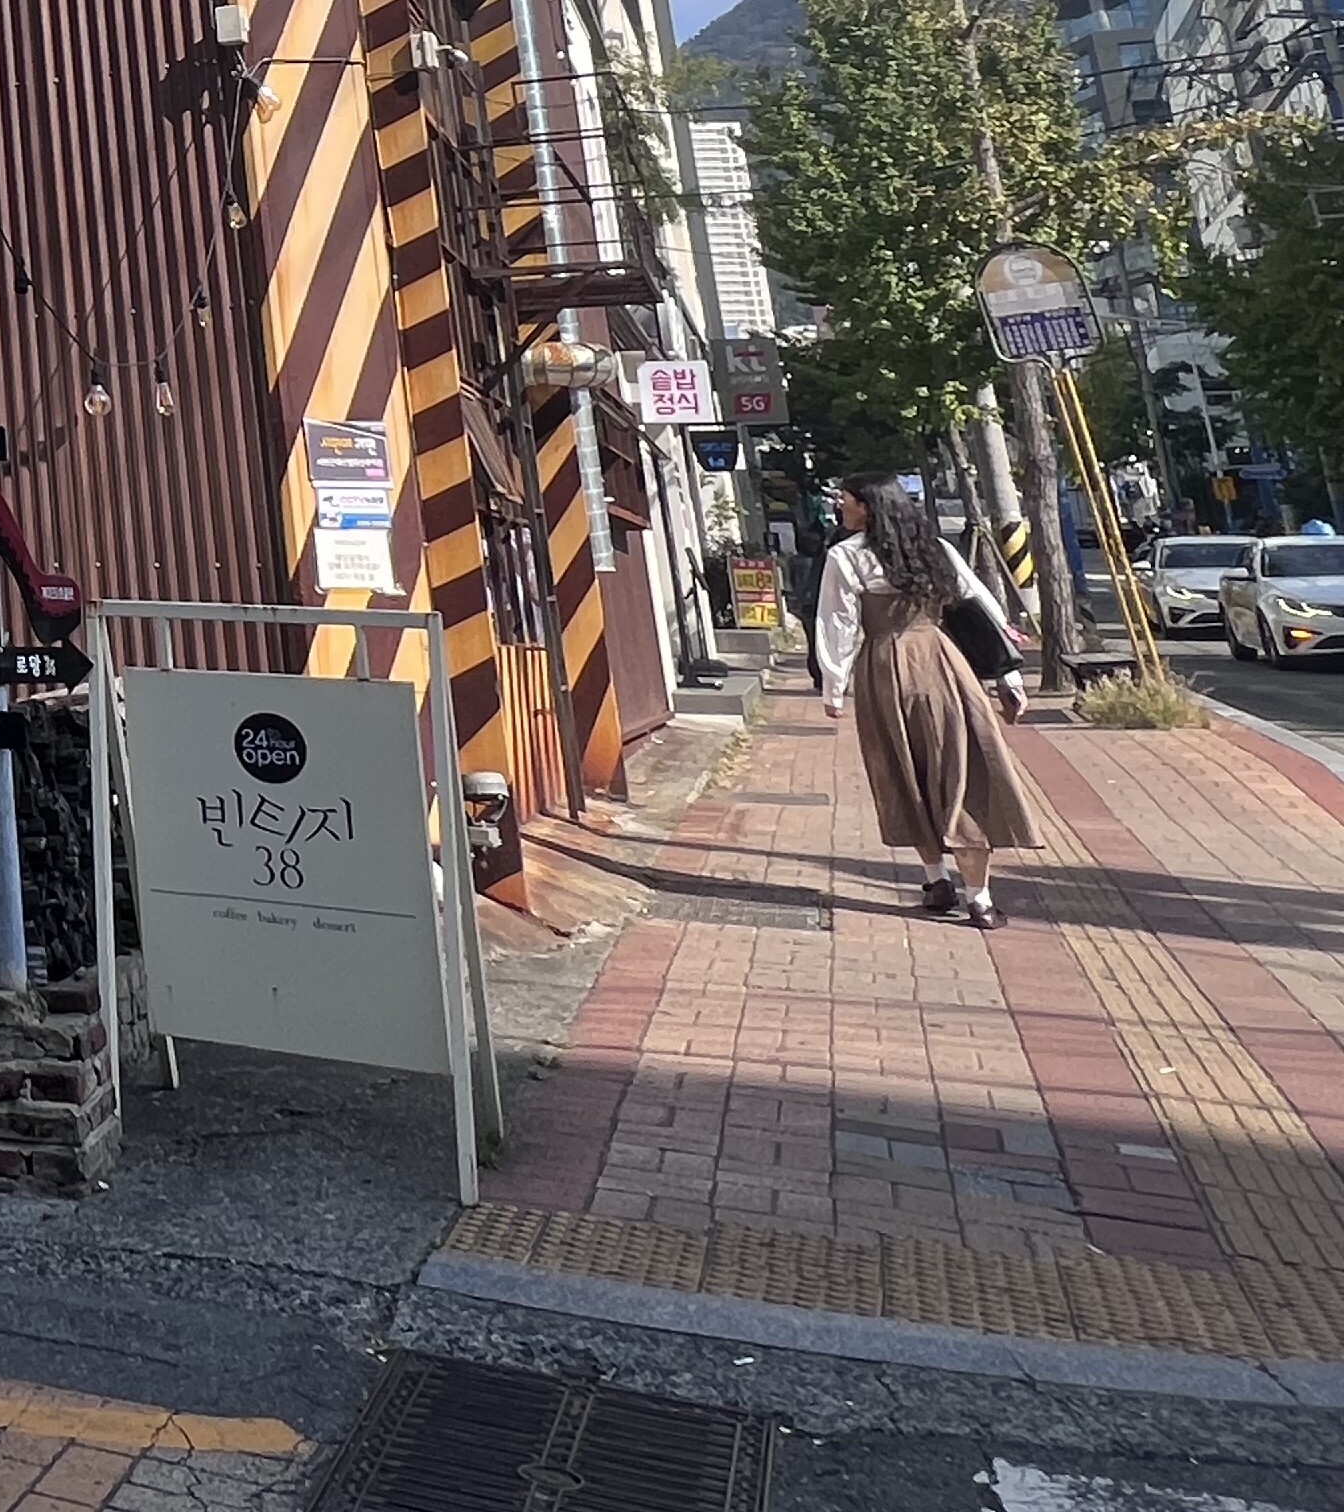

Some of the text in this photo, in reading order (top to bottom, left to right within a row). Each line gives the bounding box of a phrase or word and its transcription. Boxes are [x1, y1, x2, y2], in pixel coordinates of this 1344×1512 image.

[725, 344, 768, 373] kt
[652, 392, 699, 416] 정식
[740, 395, 766, 412] 5G
[241, 728, 268, 748] 24
[242, 748, 300, 767] open
[196, 789, 354, 847] 빈티지
[253, 846, 304, 889] 38
[257, 910, 297, 931] bakery
